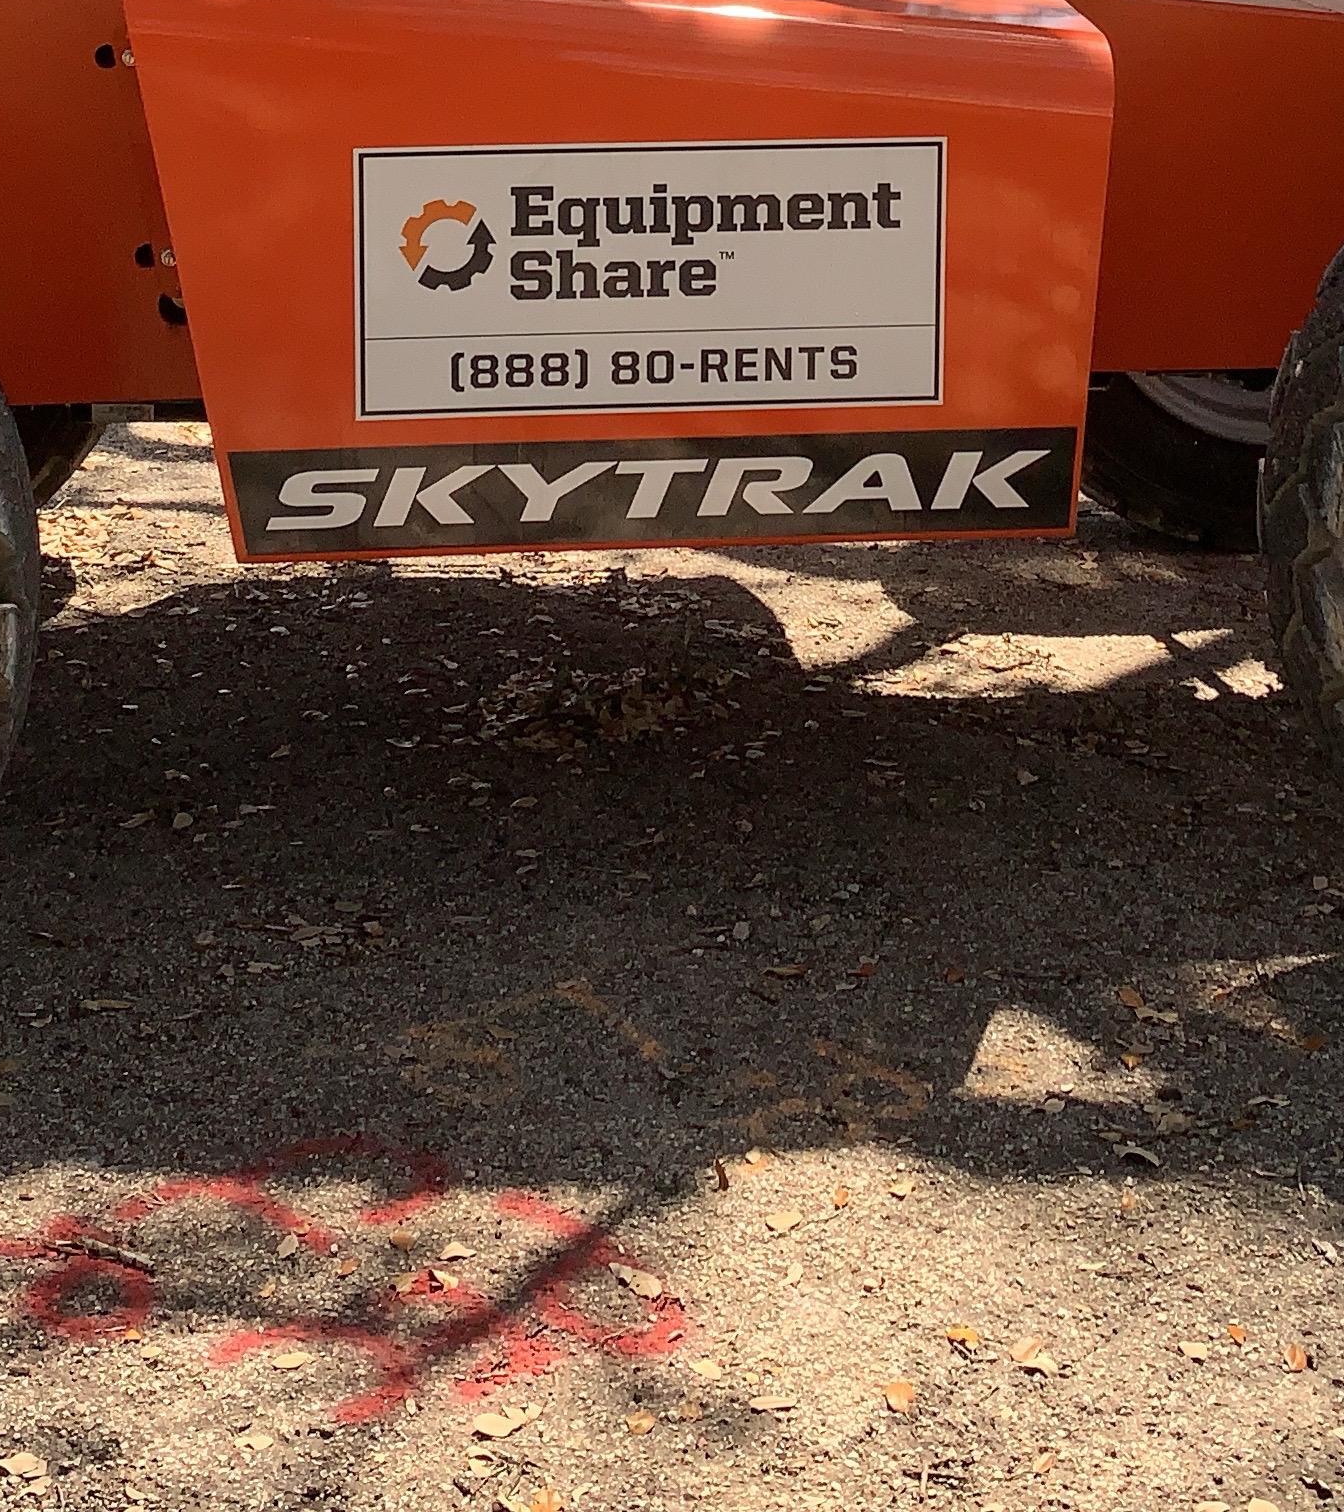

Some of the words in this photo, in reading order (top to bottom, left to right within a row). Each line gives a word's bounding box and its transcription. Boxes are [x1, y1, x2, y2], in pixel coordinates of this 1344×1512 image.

[509, 181, 902, 248] Equipment
[509, 248, 718, 302] Share
[450, 348, 590, 392] (888)
[610, 345, 858, 386] 80-RENTS
[266, 448, 1052, 533] SKYTRAK
